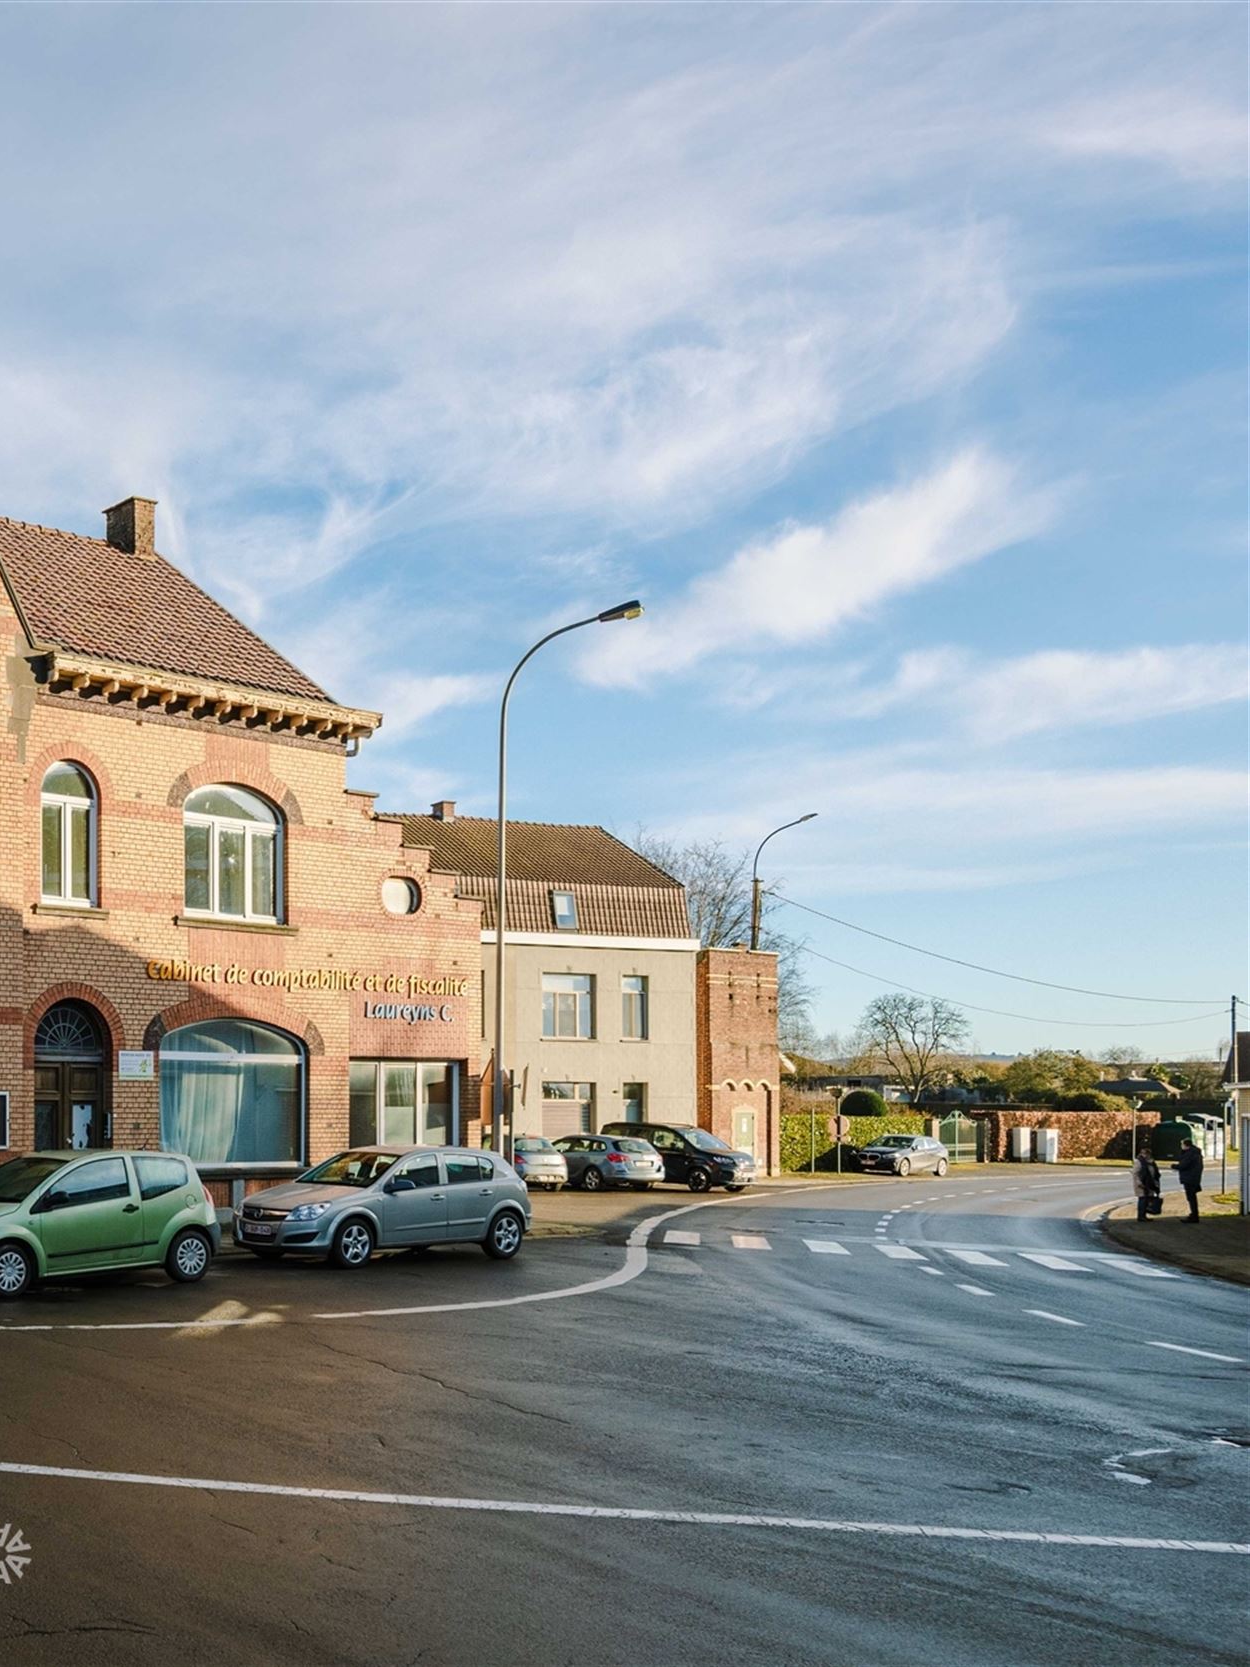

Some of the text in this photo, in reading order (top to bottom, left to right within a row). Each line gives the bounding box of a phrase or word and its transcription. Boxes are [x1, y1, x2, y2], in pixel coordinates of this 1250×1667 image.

[147, 959, 468, 999] Cabinet de comptabilité et de fiscalité
[364, 1001, 454, 1025] Laureyns C.
